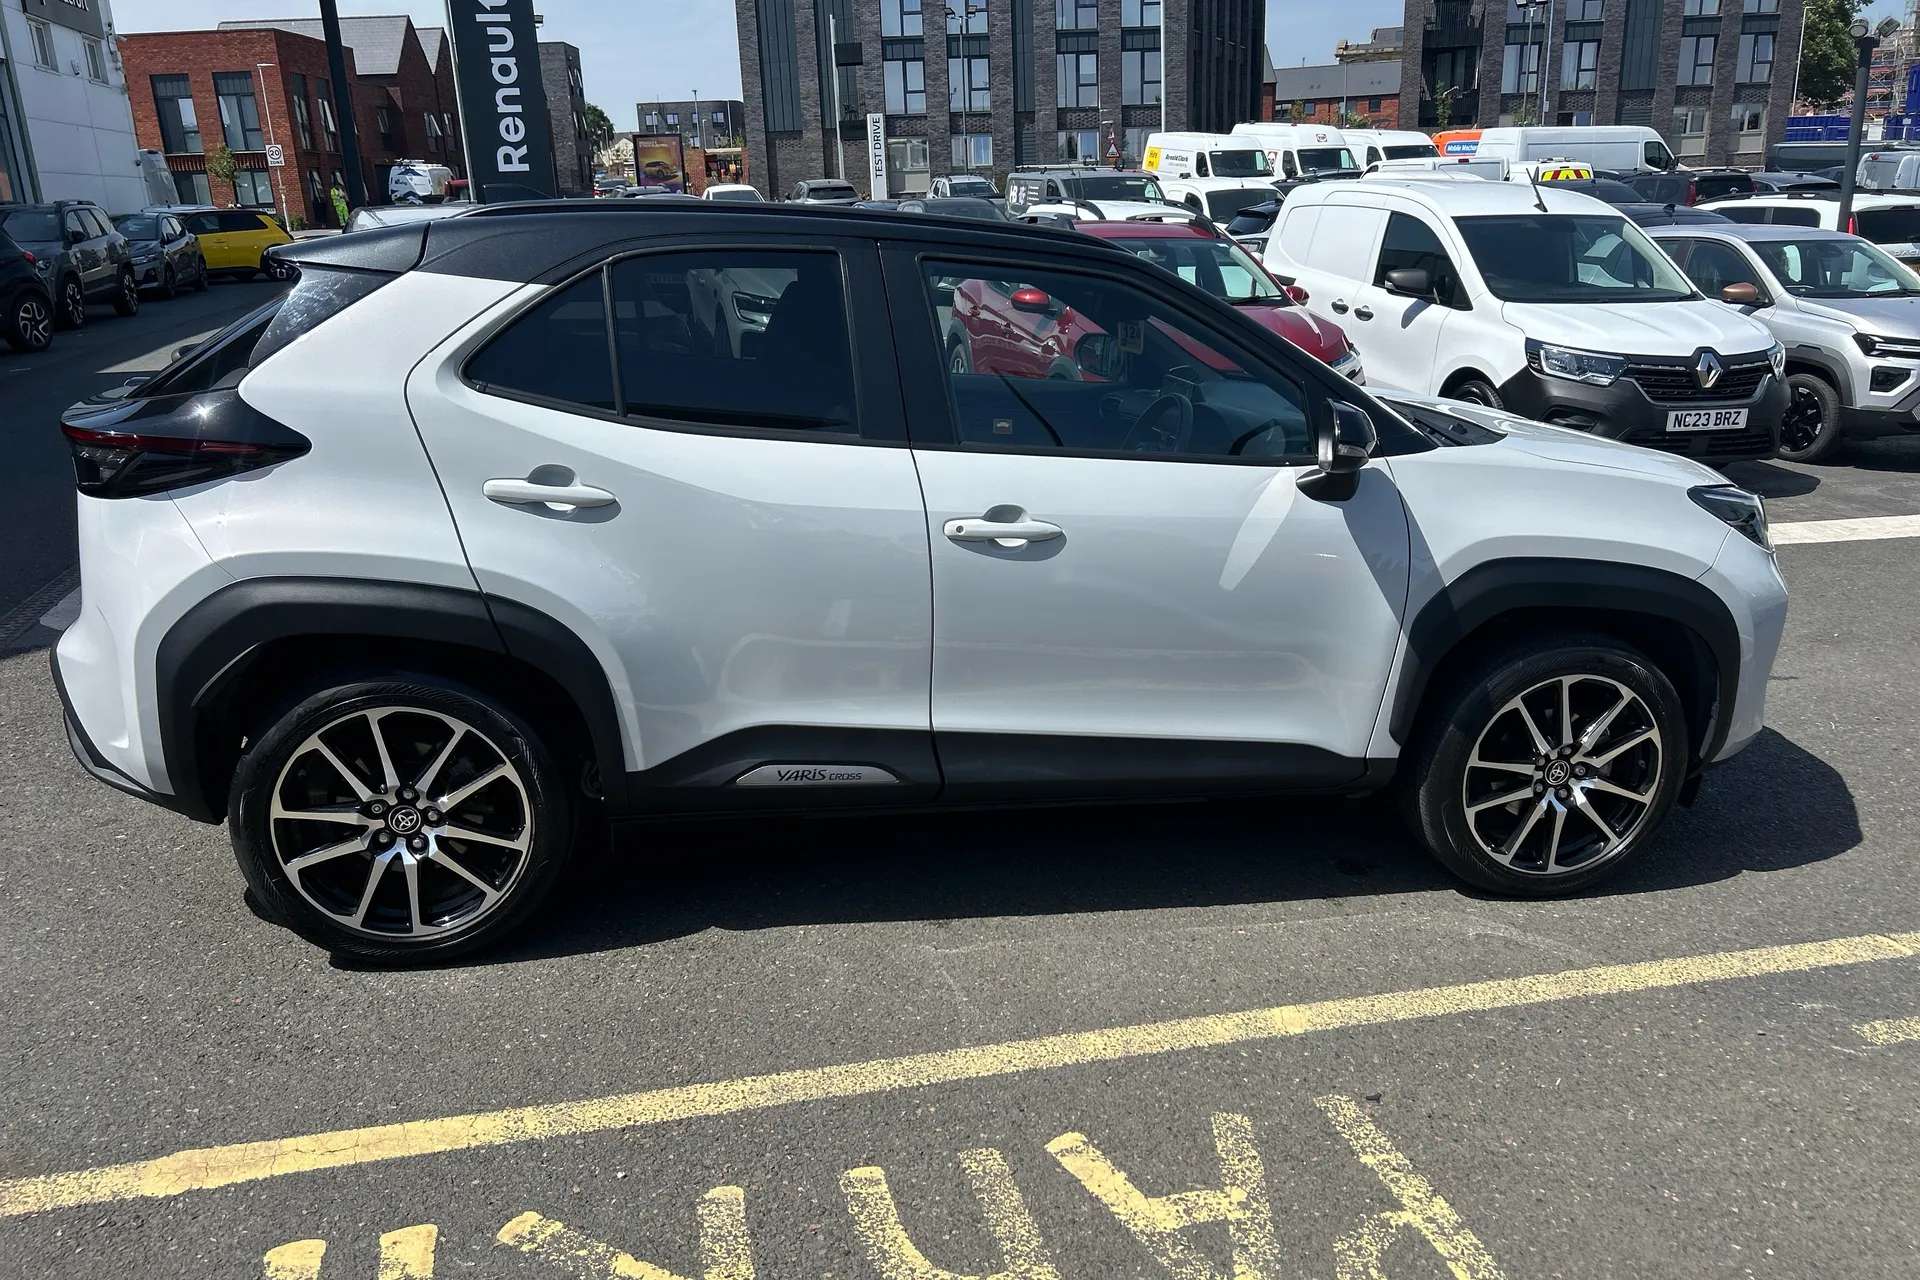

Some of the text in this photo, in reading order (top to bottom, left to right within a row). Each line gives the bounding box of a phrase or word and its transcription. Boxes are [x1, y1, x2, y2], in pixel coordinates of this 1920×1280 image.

[270, 149, 280, 157] 20
[872, 117, 883, 179] TEST DRIVE
[1673, 411, 1742, 428] NC23 BRZ
[829, 773, 863, 781] CROSS
